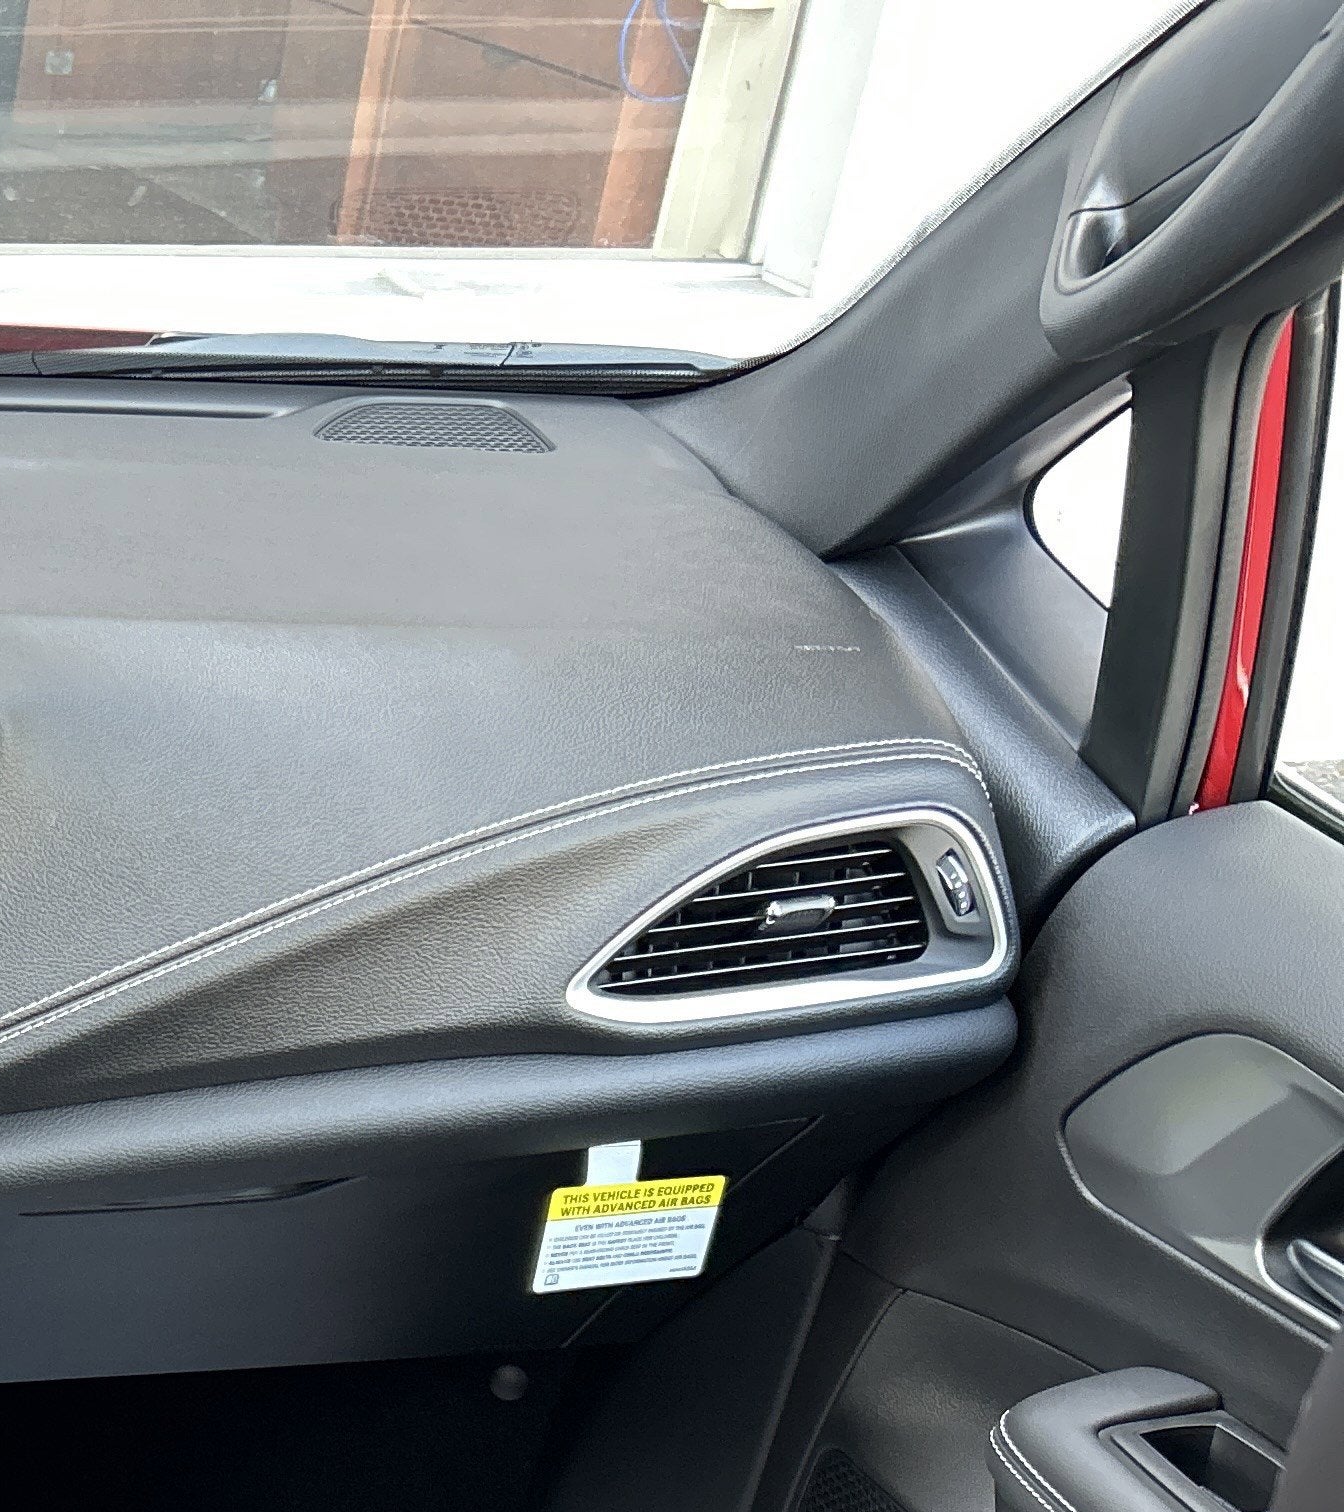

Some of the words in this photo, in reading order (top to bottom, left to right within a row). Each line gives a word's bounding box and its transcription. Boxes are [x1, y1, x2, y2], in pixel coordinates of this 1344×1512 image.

[562, 1194, 590, 1205] THIS
[593, 1188, 641, 1202] VEHICLE
[643, 1187, 655, 1198] IS
[657, 1182, 715, 1197] EQUIPPED
[560, 1204, 591, 1217] WITH
[592, 1199, 657, 1215] ADVANCED
[658, 1198, 678, 1208] AIR
[680, 1194, 712, 1206] BAGS
